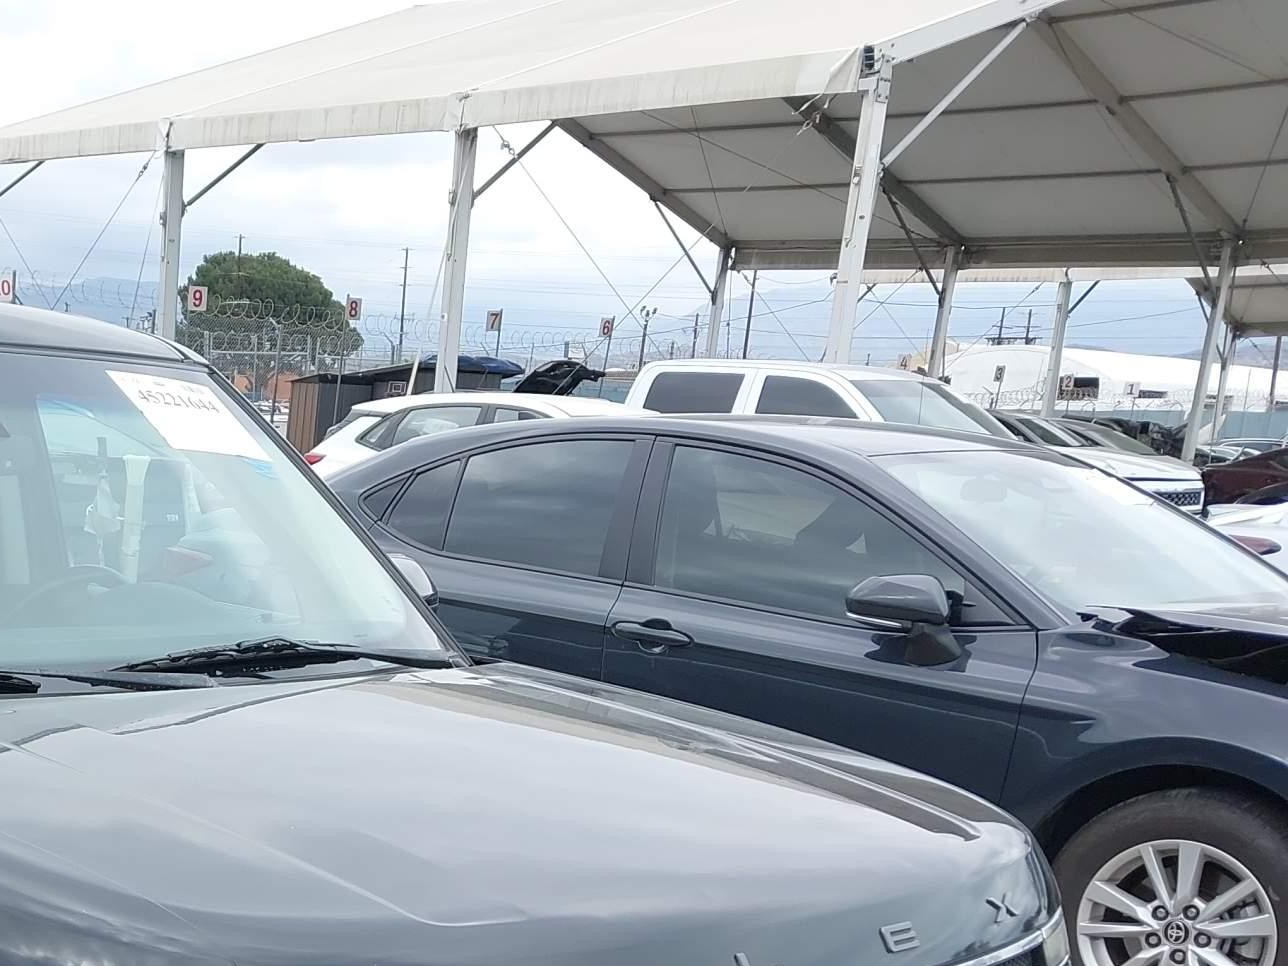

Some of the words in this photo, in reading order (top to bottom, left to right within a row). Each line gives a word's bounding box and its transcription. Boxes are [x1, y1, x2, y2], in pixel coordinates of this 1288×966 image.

[192, 289, 203, 308] 9
[348, 300, 358, 318] 8
[489, 312, 500, 330] 7
[602, 319, 611, 336] 6
[899, 355, 909, 370] 4
[995, 366, 1004, 380] 3
[1064, 375, 1073, 388] 2
[1126, 383, 1135, 395] 1
